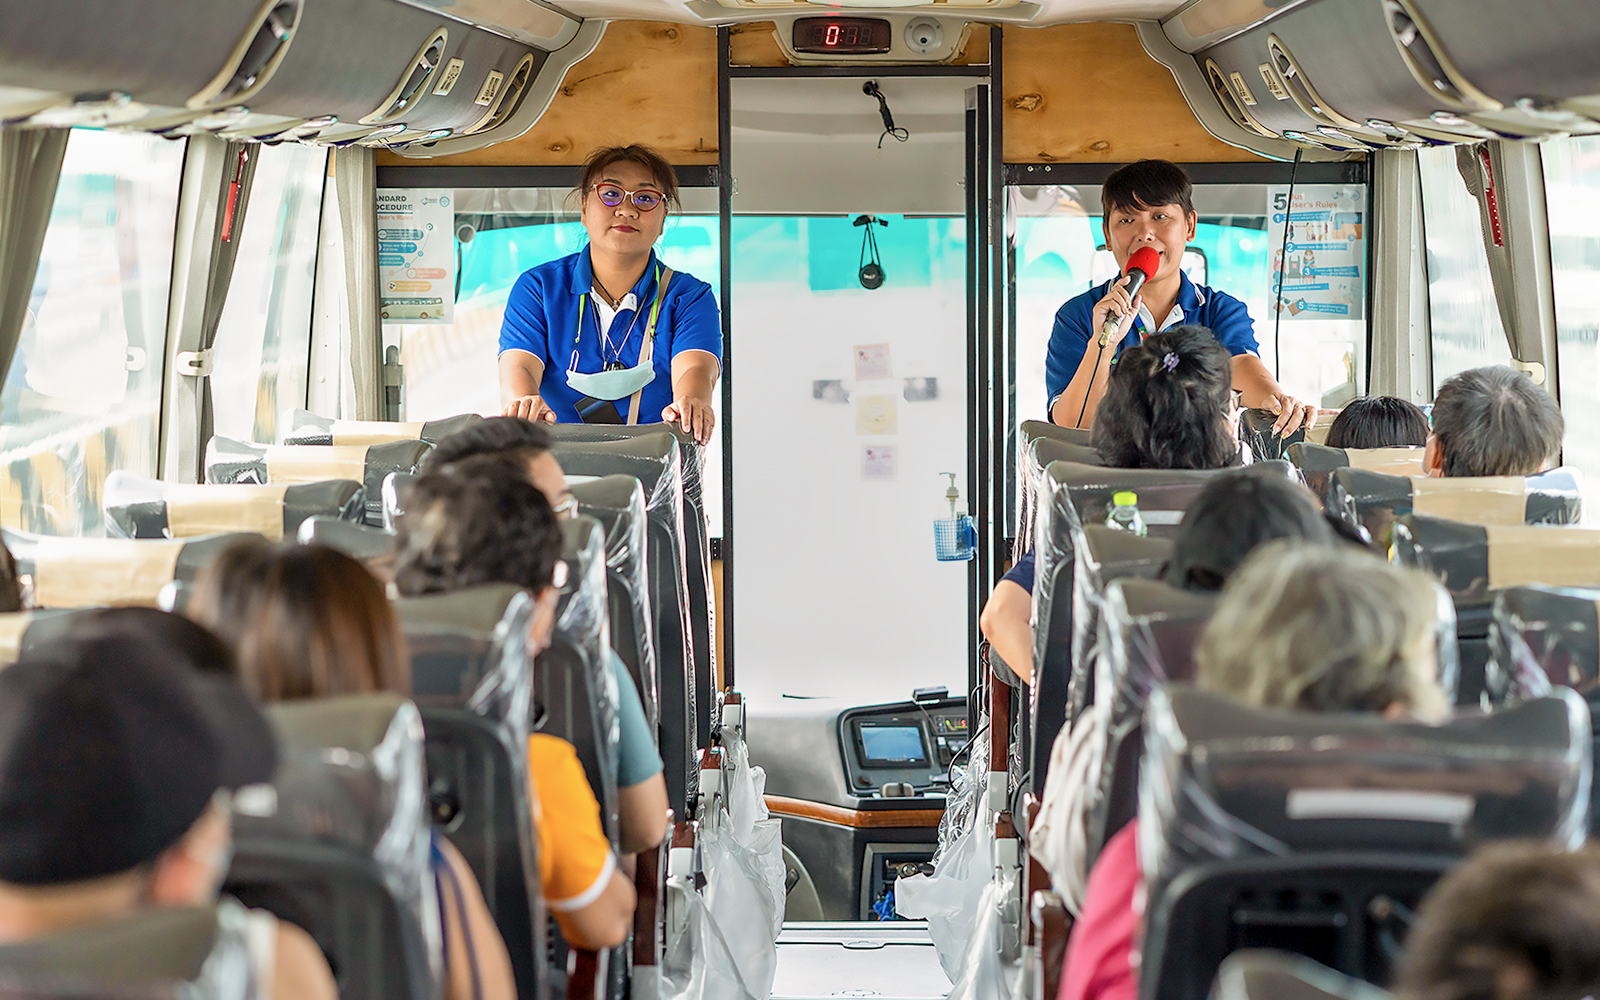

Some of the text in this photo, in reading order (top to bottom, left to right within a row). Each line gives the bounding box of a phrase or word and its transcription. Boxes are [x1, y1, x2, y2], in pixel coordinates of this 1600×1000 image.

[1273, 193, 1287, 210] 5
[1287, 243, 1293, 252] 2
[1304, 267, 1310, 276] 3
[1298, 301, 1304, 309] 5
